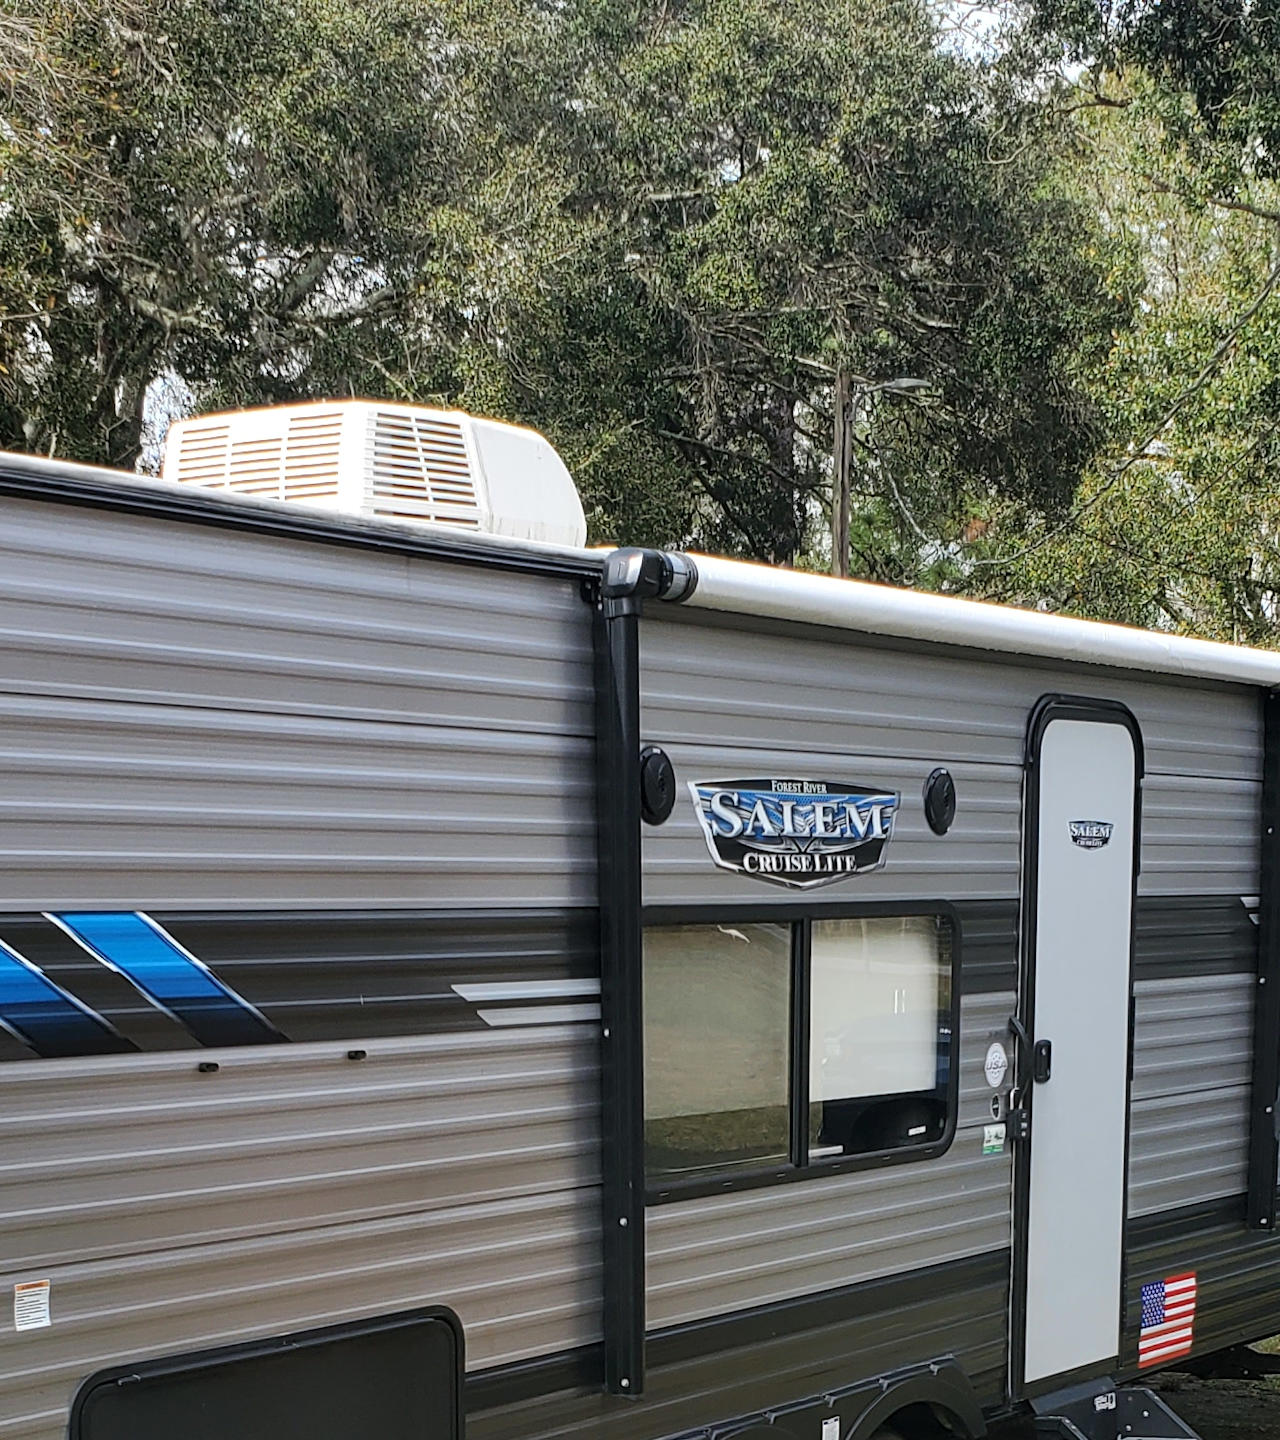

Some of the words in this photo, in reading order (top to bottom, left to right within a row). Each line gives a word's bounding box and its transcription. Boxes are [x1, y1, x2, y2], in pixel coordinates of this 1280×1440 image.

[771, 780, 802, 793] FOREST
[803, 781, 827, 794] RIVER
[710, 791, 890, 839] SALEM
[1071, 823, 1110, 837] SALEM
[986, 1060, 1007, 1071] USA
